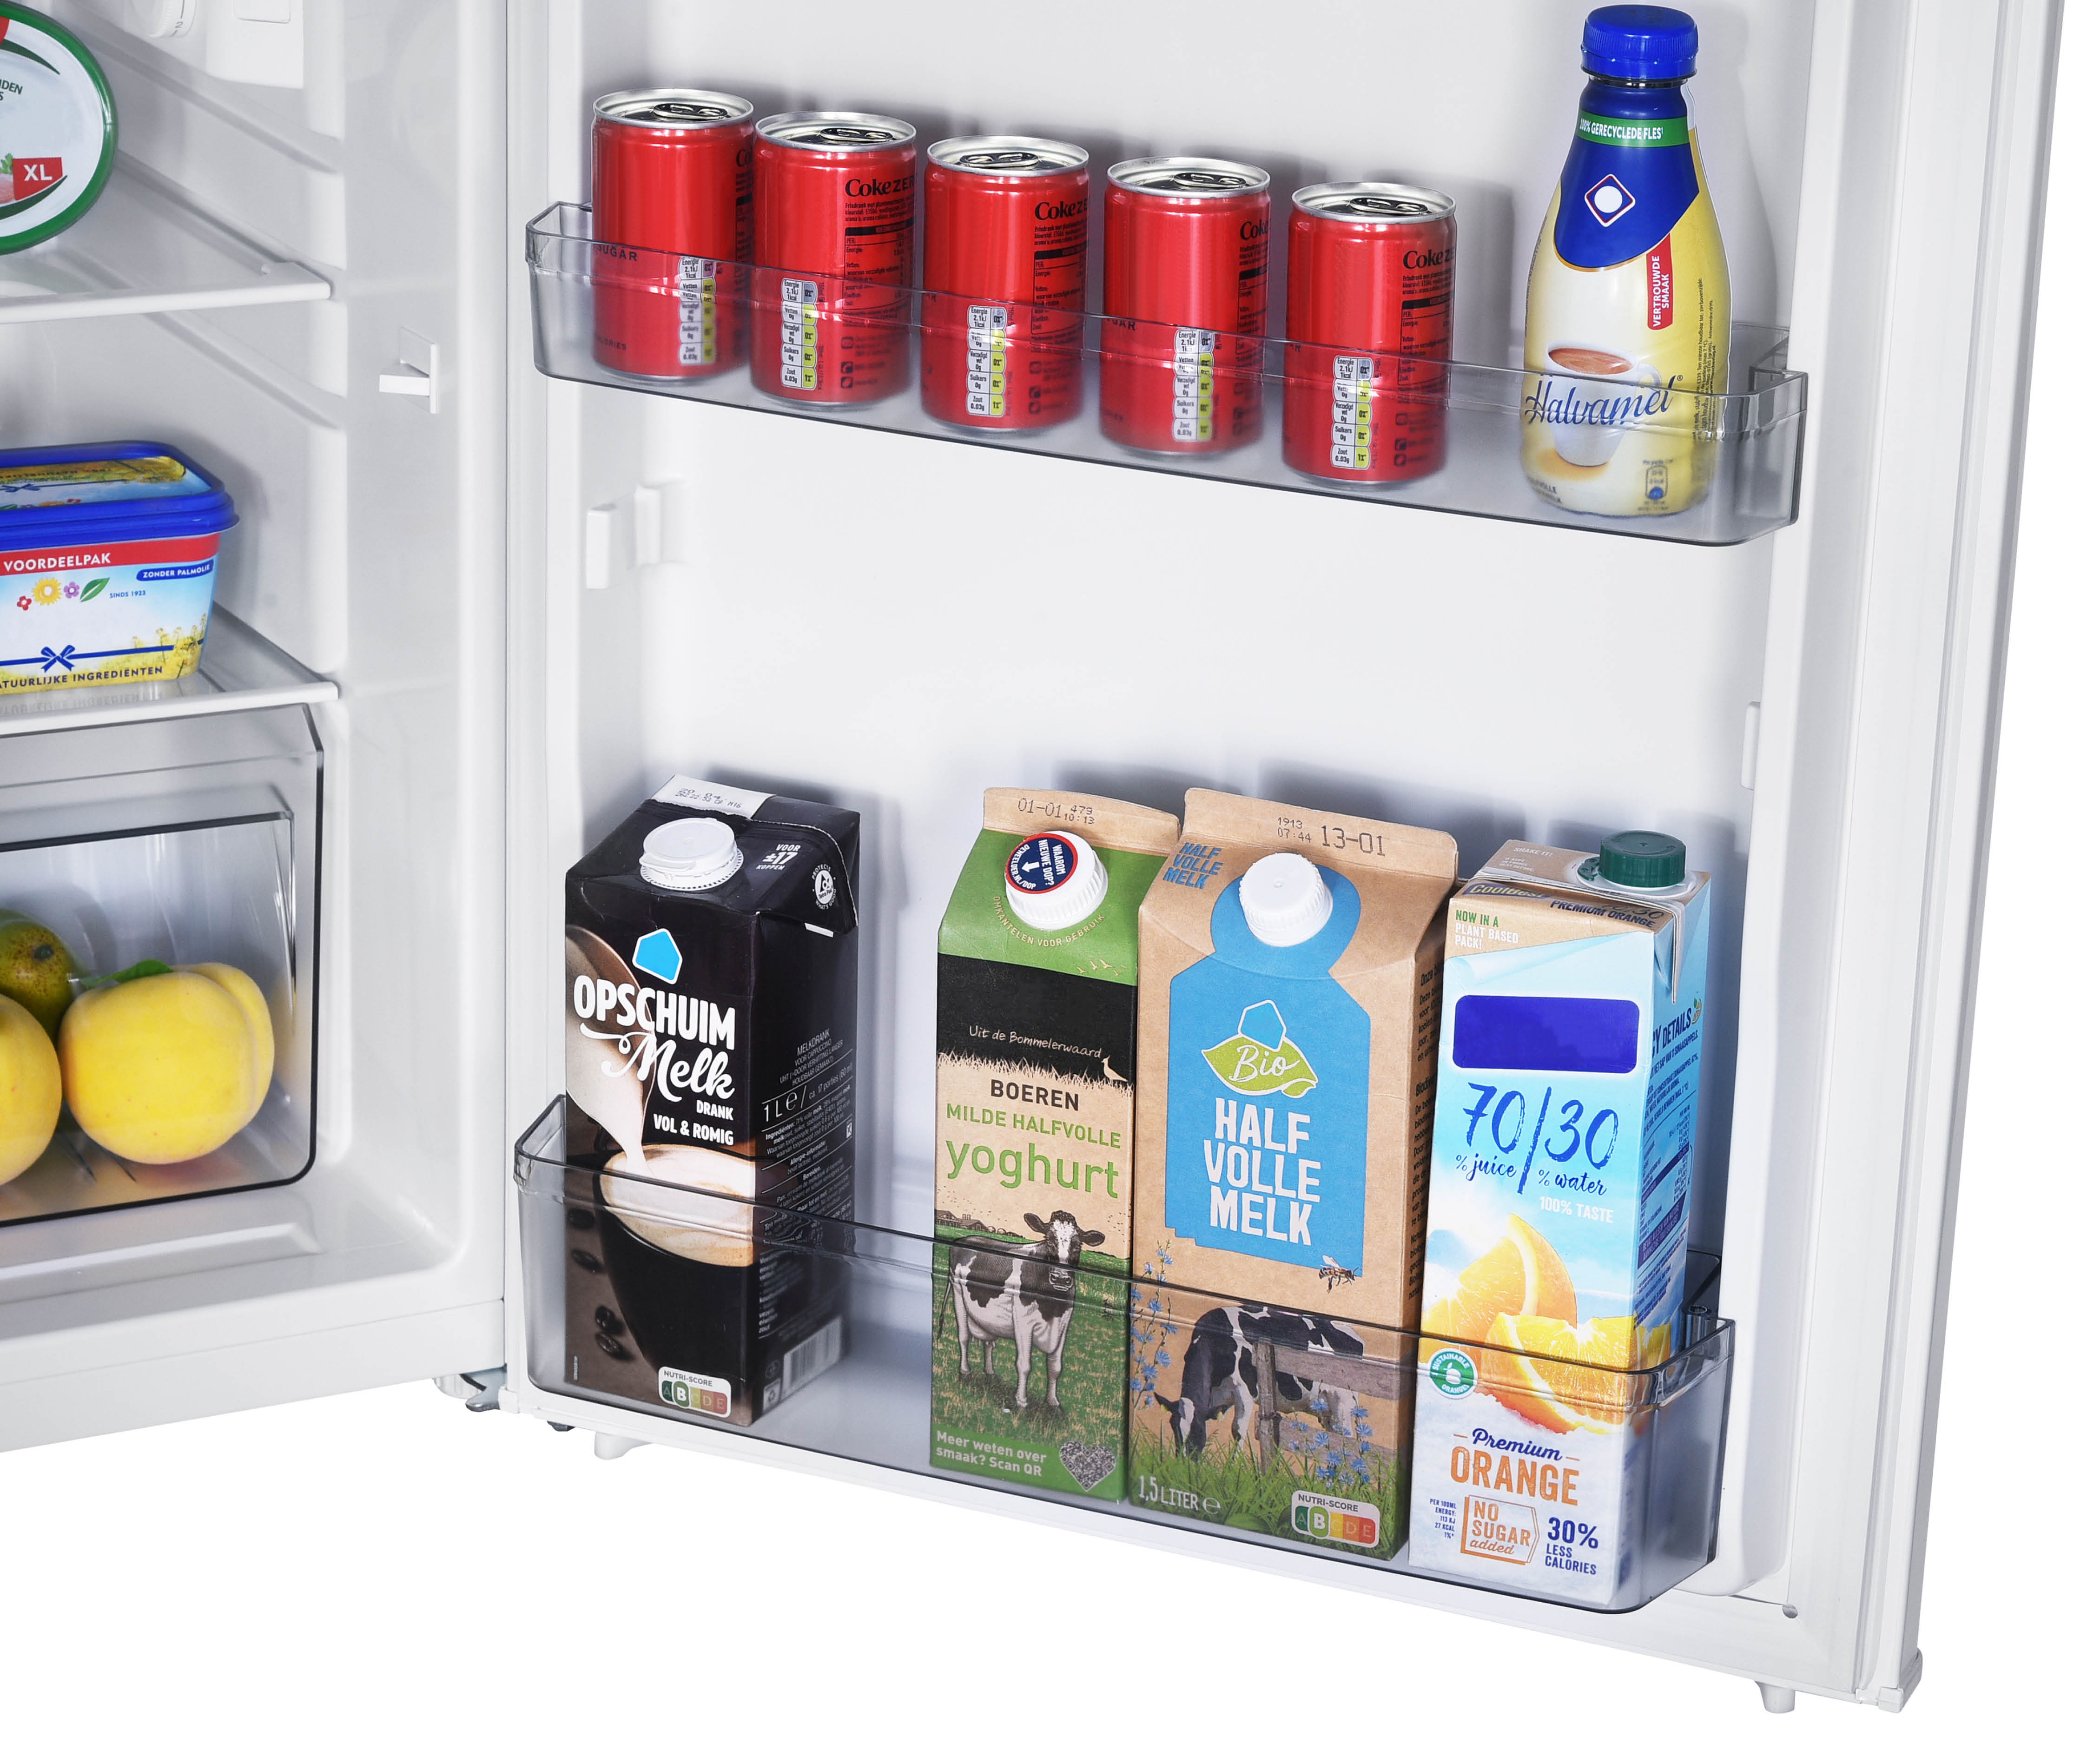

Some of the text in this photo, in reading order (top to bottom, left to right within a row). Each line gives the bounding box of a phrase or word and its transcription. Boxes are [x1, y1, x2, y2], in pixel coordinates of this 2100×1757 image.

[0, 79, 23, 95] DEN
[1591, 122, 1644, 140] GERECYCLEDE
[24, 164, 53, 181] XL
[1403, 249, 1443, 269] Coke
[784, 280, 799, 289] Energie
[1651, 255, 1661, 327] VERTROUWDE
[1661, 274, 1670, 309] SMAAK
[971, 307, 988, 316] Energie
[785, 375, 797, 384] 0.03g
[970, 374, 987, 383] Suikers
[971, 403, 985, 411] 0.03g
[1525, 376, 1677, 425] Halvamel
[1335, 455, 1350, 464] 0.03g
[3, 552, 111, 573] VOORDEELPAK
[143, 564, 211, 579] ZONDER PALMOLIE
[73, 665, 163, 682] INGREDIËNTEN
[1018, 798, 1062, 818] 01-01
[1063, 813, 1095, 825] 10:13
[1277, 827, 1312, 844] 07:44
[1277, 817, 1386, 858] 1913 13-01
[762, 852, 799, 865] ±17
[776, 844, 801, 852] VOOR
[1180, 842, 1222, 859] HALF
[1038, 839, 1055, 886] NIEUWE DOP?
[1052, 844, 1066, 875] WAAROM
[1172, 853, 1223, 876] VOLLE
[812, 864, 832, 880] PROTECTS
[1163, 866, 1210, 890] MELK
[993, 895, 1105, 947] OMKANTELEN VOOR GEBRUIK
[1456, 909, 1499, 928] NOW IN A
[1550, 899, 1656, 928] PREMIUM ORANGE
[1455, 922, 1519, 944] PLANT BASED
[1455, 935, 1482, 950] PACK!
[574, 975, 735, 1050] OPSCHUIM
[1663, 1007, 1692, 1049] DETAILS
[797, 1028, 830, 1057] MELKDRANK
[969, 1025, 1102, 1059] Uit de Bommelerwaard
[600, 1026, 735, 1103] Melk
[1228, 1044, 1301, 1082] Bio
[991, 1079, 1079, 1111] BOEREN
[696, 1100, 733, 1121] DRANK
[653, 1113, 734, 1146] VOL & ROMIG
[947, 1103, 1121, 1149] MILDE HALFVOLLE
[1215, 1097, 1311, 1154] HALF
[945, 1140, 1119, 1199] yoghurt
[1203, 1139, 1322, 1203] VOLLE
[1466, 1153, 1517, 1182] juice
[1555, 1172, 1607, 1196] water
[1209, 1184, 1313, 1247] MELK
[1539, 1196, 1614, 1223] 100% TASTE
[1432, 1353, 1470, 1371] SUSTAINABLE
[663, 1370, 713, 1387] NUTRI-SCORE
[676, 1387, 687, 1401] B
[937, 1430, 1047, 1463] Meer weten over
[1472, 1427, 1563, 1461] Premium
[936, 1447, 1042, 1477] smaak? Scan QR
[1451, 1446, 1580, 1506] ORANGE
[1138, 1475, 1199, 1511] 1,5 LITER
[1298, 1493, 1359, 1513] NUTRI-SCORE
[1435, 1506, 1456, 1517] ENERGY:
[1441, 1500, 1457, 1509] 100ML
[1474, 1499, 1499, 1522] NO
[1314, 1514, 1326, 1530] B
[1442, 1524, 1455, 1532] KCAL
[1472, 1519, 1532, 1547] SUGAR
[1547, 1516, 1599, 1550] 30%
[1470, 1539, 1515, 1555] added
[1545, 1543, 1573, 1559] LESS
[1545, 1555, 1597, 1575] CALORIES
